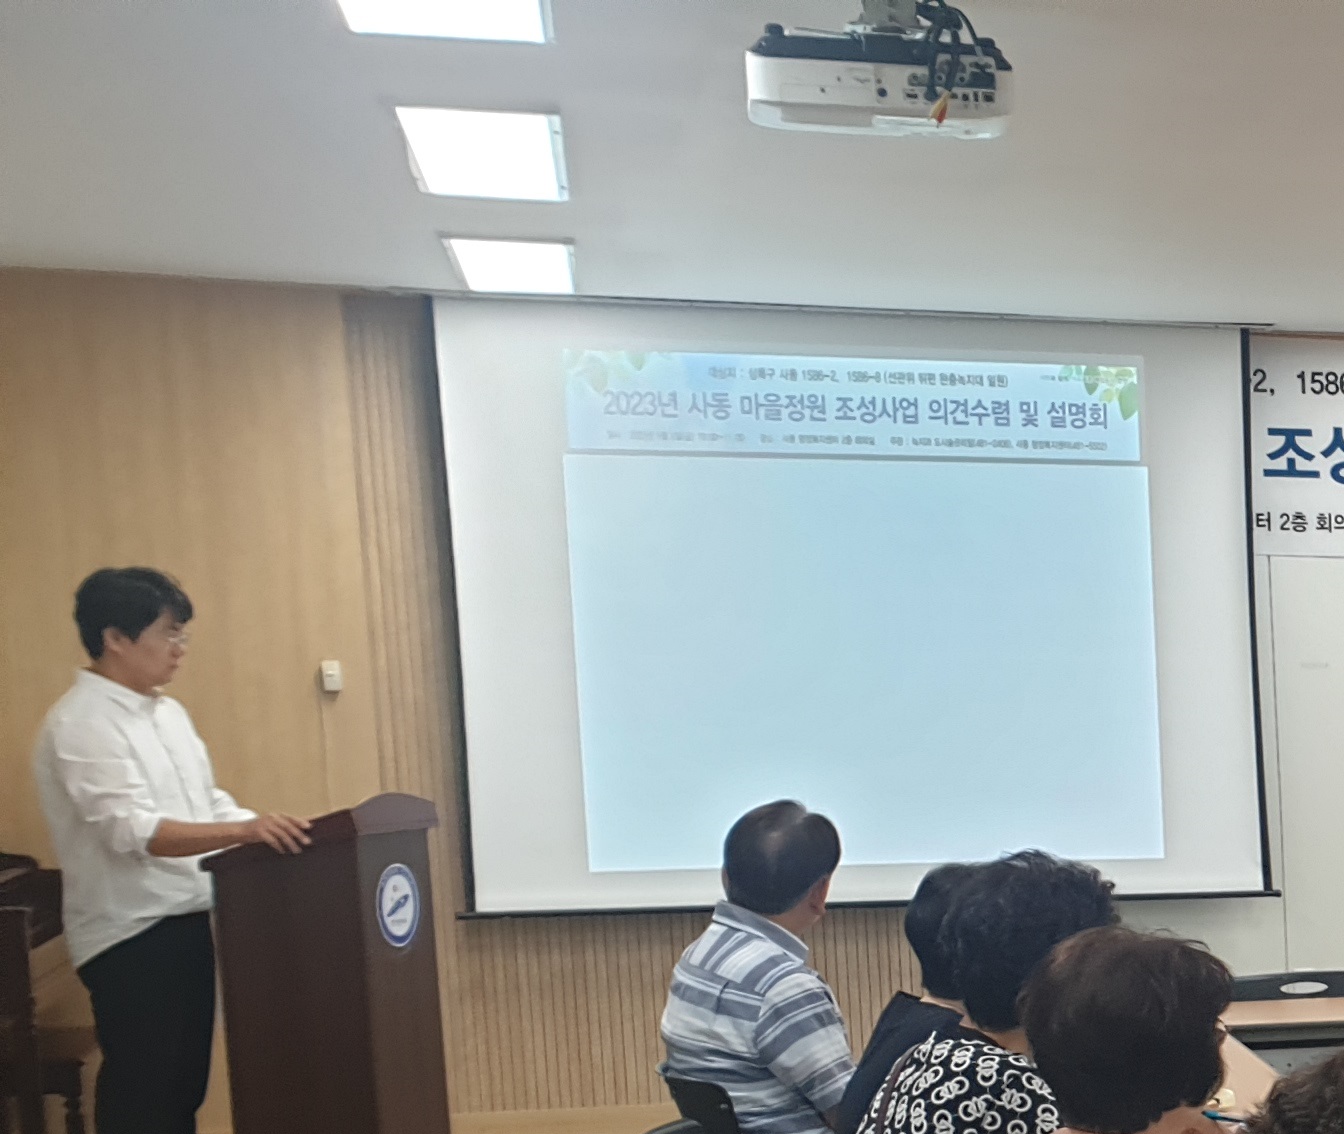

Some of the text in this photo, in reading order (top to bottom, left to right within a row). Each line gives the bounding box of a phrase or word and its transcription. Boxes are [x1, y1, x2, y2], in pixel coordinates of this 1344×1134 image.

[1250, 368, 1275, 396] 2,
[604, 390, 1107, 429] 2023년 사동 마을정원 조성사업 의견수렴 및 설명회
[1280, 512, 1308, 532] 2층
